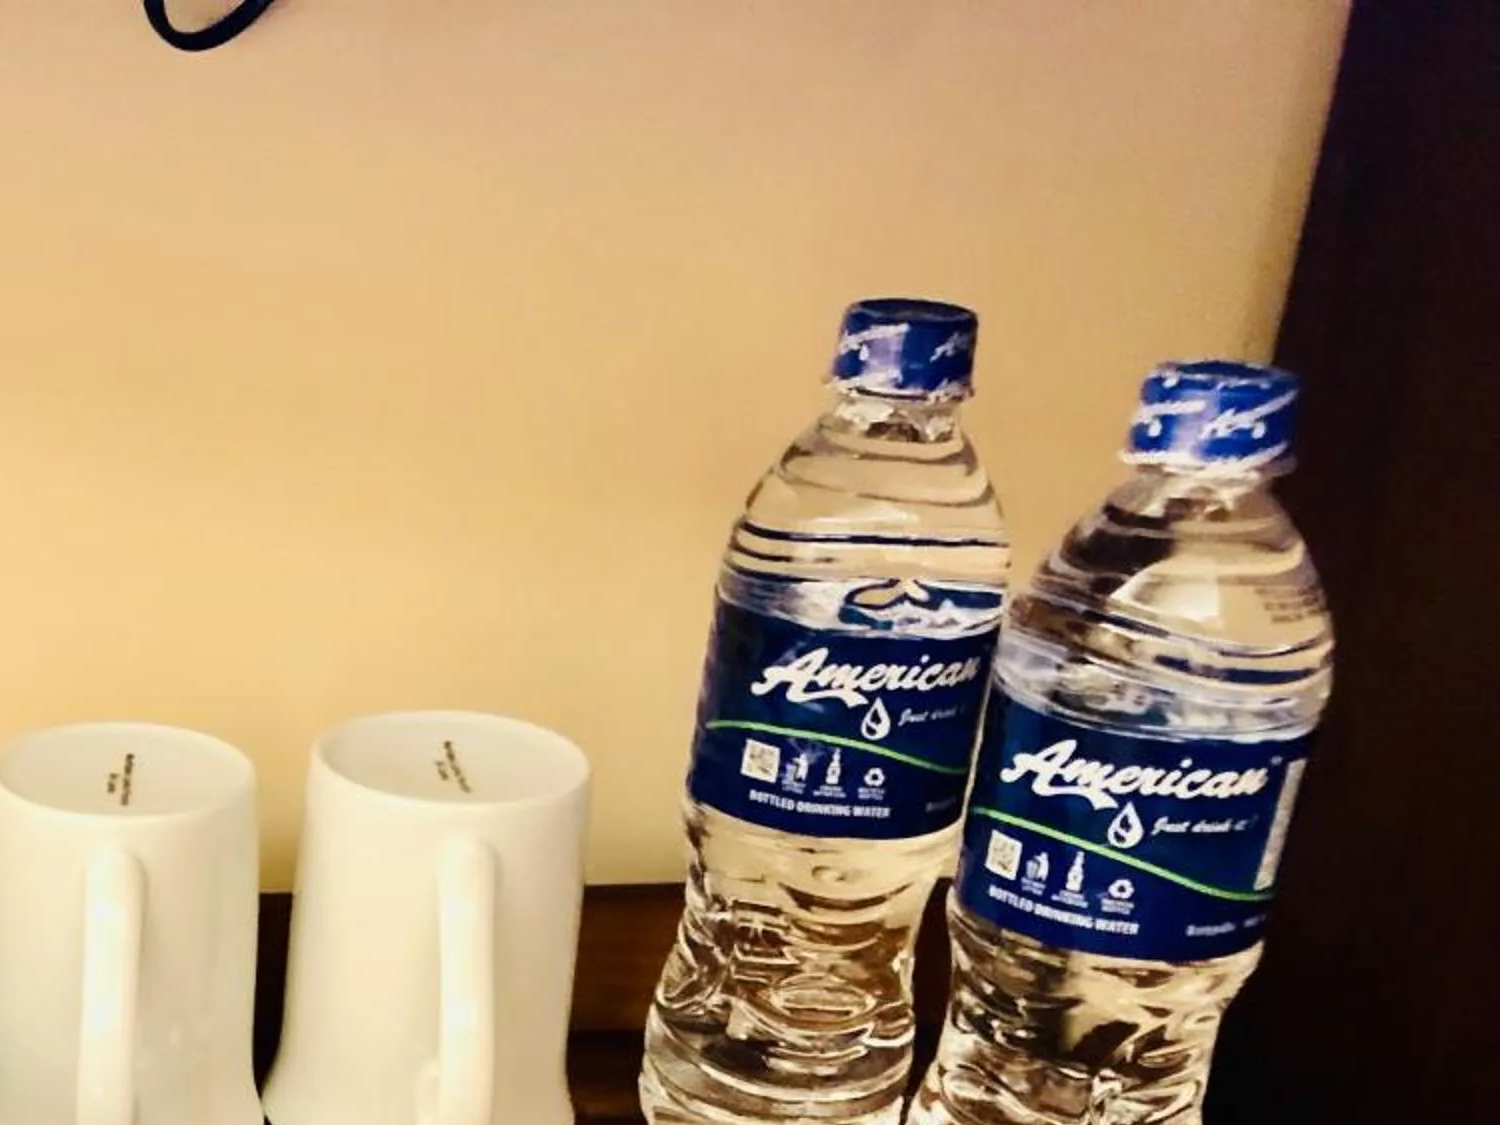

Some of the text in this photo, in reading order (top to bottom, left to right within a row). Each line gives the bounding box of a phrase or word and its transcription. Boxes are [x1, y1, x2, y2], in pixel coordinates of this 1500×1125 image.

[750, 647, 981, 709] American
[1000, 739, 1268, 810] American
[749, 789, 795, 812] BOTTLED
[796, 800, 851, 817] DRINKING
[853, 806, 891, 818] WATER
[988, 884, 1034, 913] BOTTLED
[1034, 903, 1094, 929] DRINKING
[1095, 918, 1140, 935] WATER
